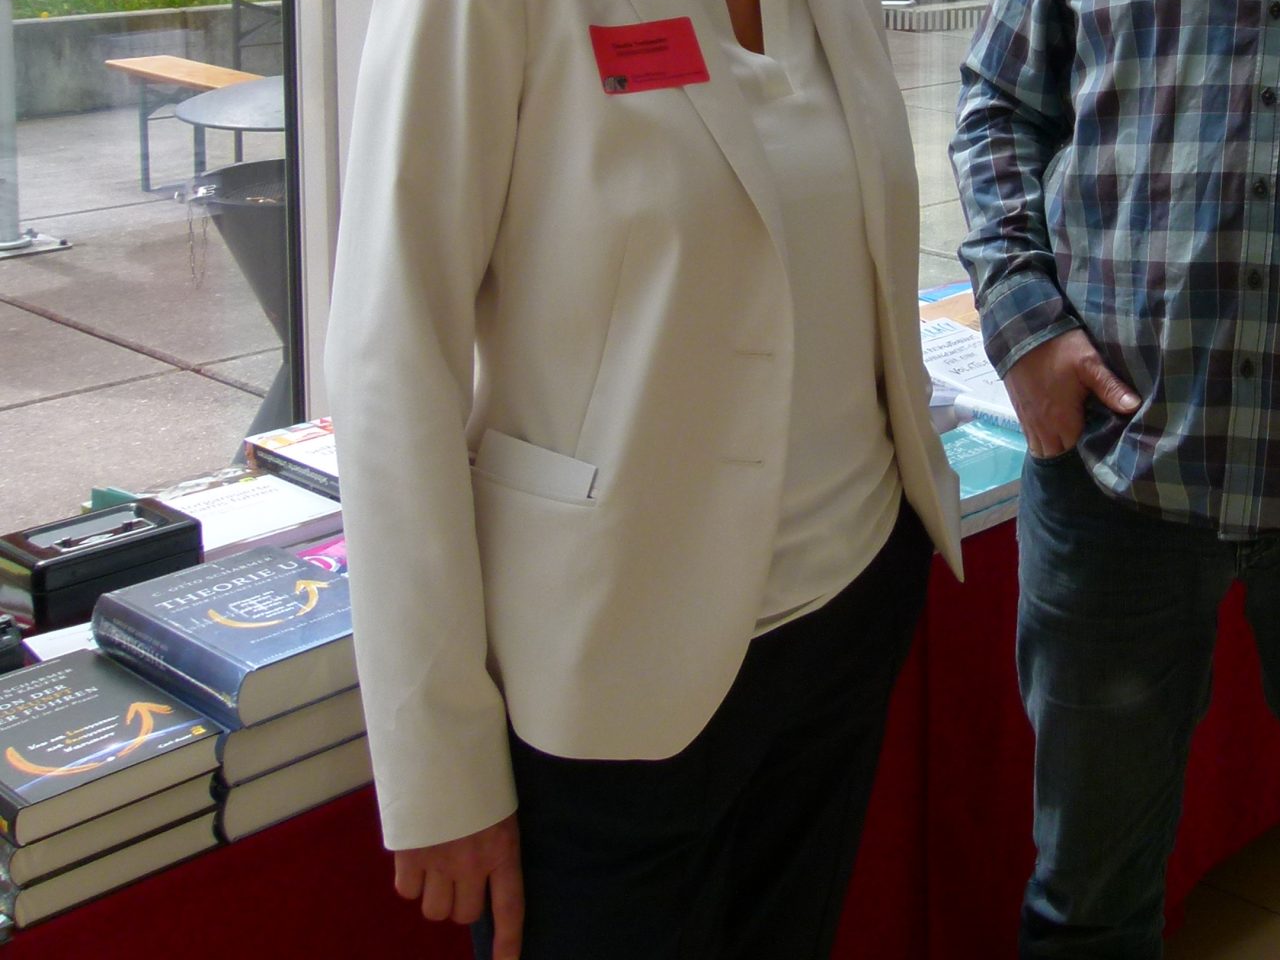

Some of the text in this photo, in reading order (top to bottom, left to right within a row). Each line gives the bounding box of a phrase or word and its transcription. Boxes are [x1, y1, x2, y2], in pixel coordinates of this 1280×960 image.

[154, 568, 277, 610] THEORIE
[277, 560, 299, 570] U
[168, 579, 203, 593] OTTO
[205, 556, 273, 580] SCHARMER
[3, 668, 73, 694] SCHARMER
[30, 684, 67, 700] DER
